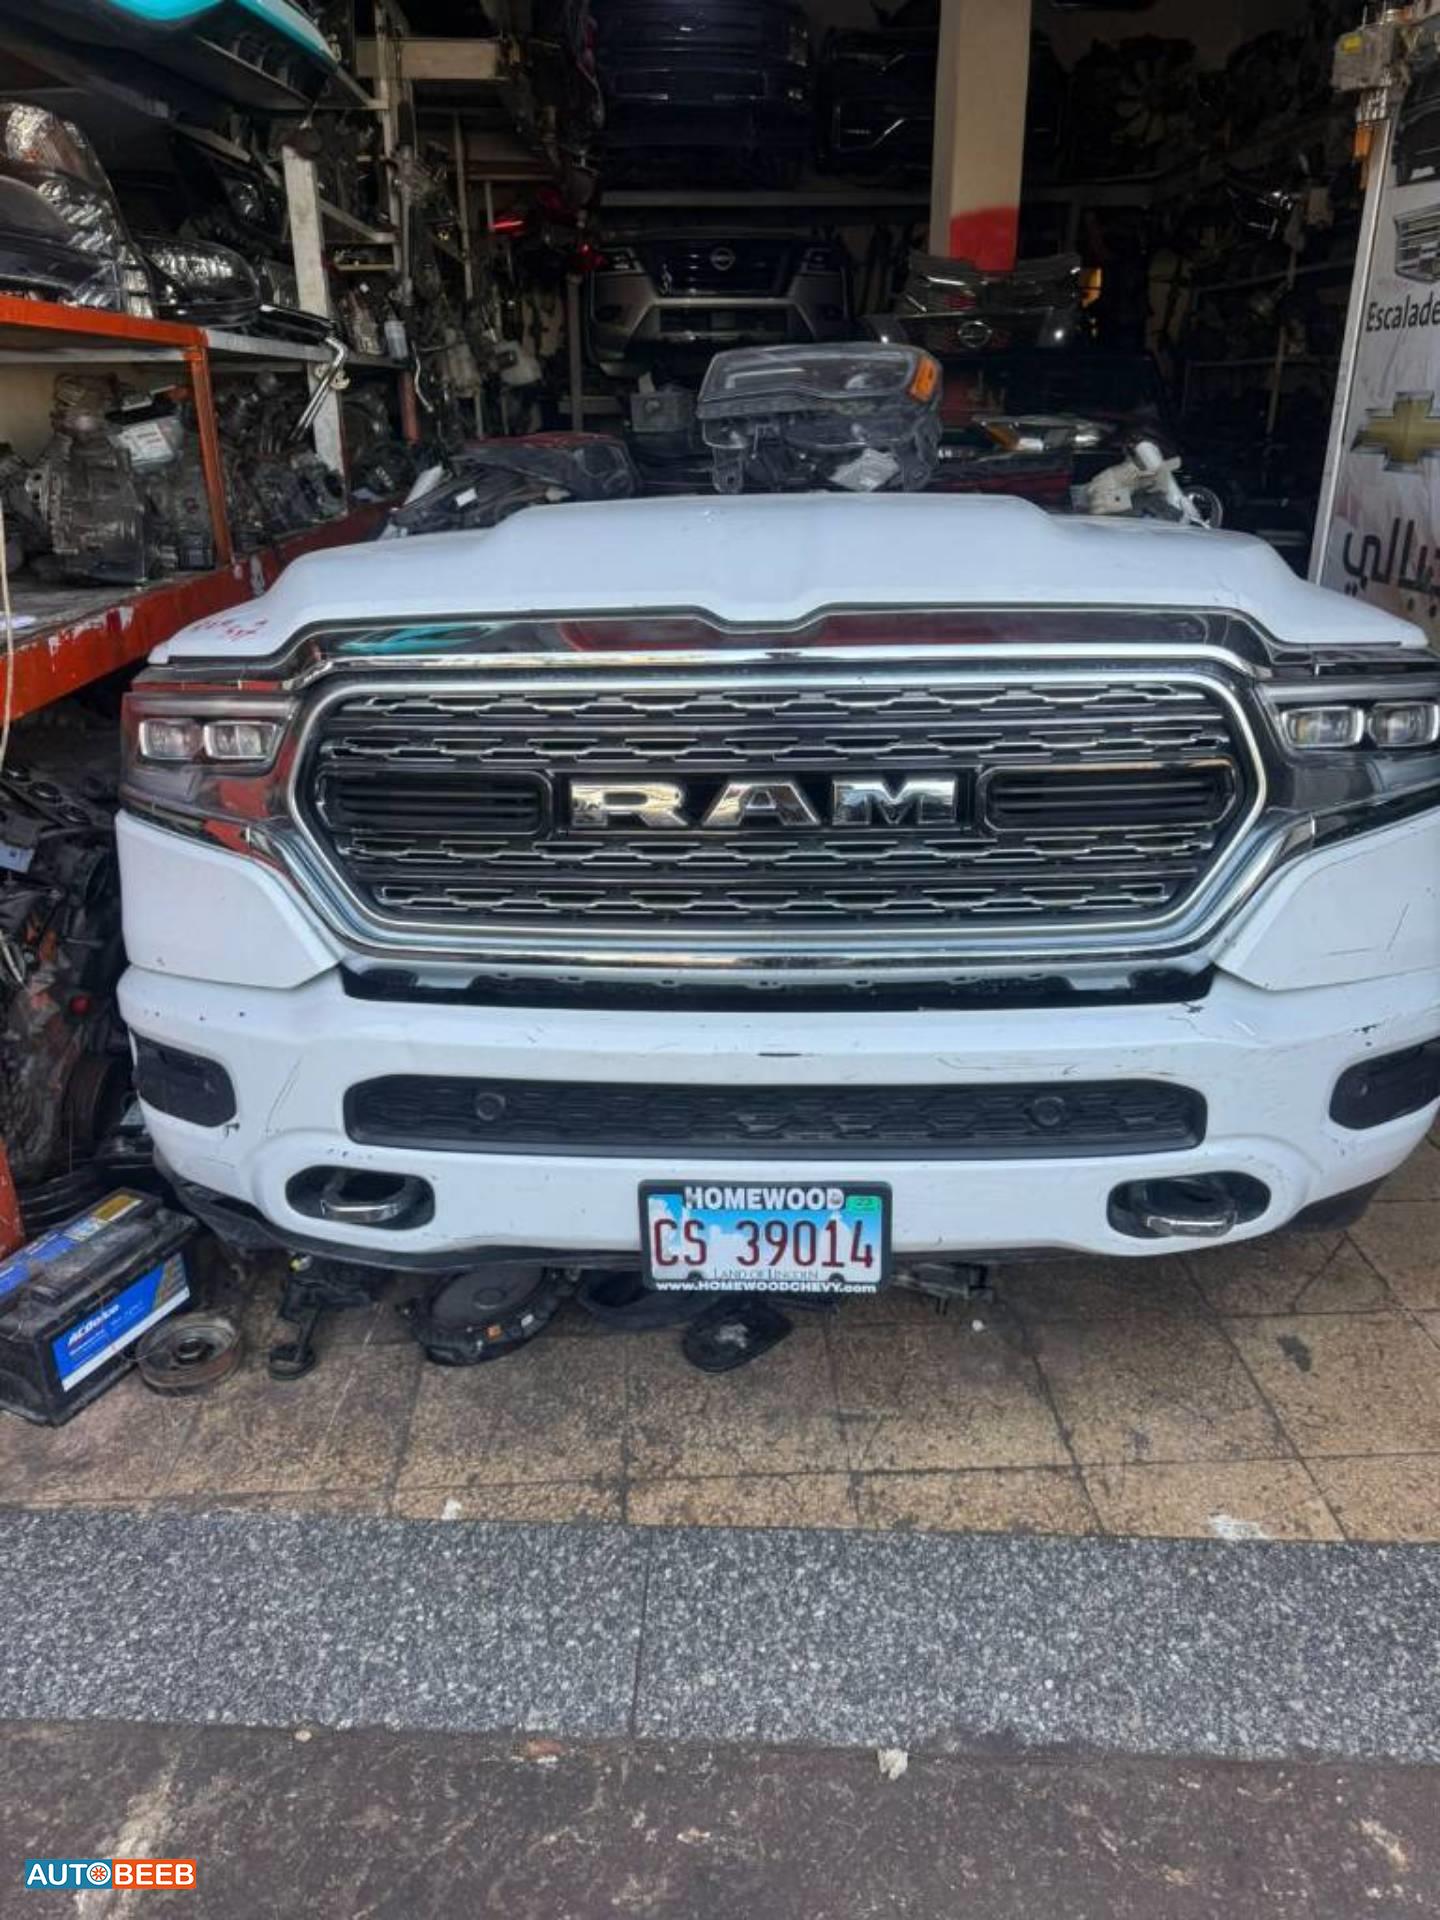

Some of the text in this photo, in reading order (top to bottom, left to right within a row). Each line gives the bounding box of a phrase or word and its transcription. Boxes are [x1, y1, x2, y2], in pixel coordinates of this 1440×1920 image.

[1366, 291, 1440, 332] Escalade
[570, 781, 958, 827] RAM
[684, 1187, 845, 1210] HOMEWOOD
[654, 1219, 873, 1268] CS 39014
[656, 1280, 877, 1293] www.HOMEWOODCHEVY.com
